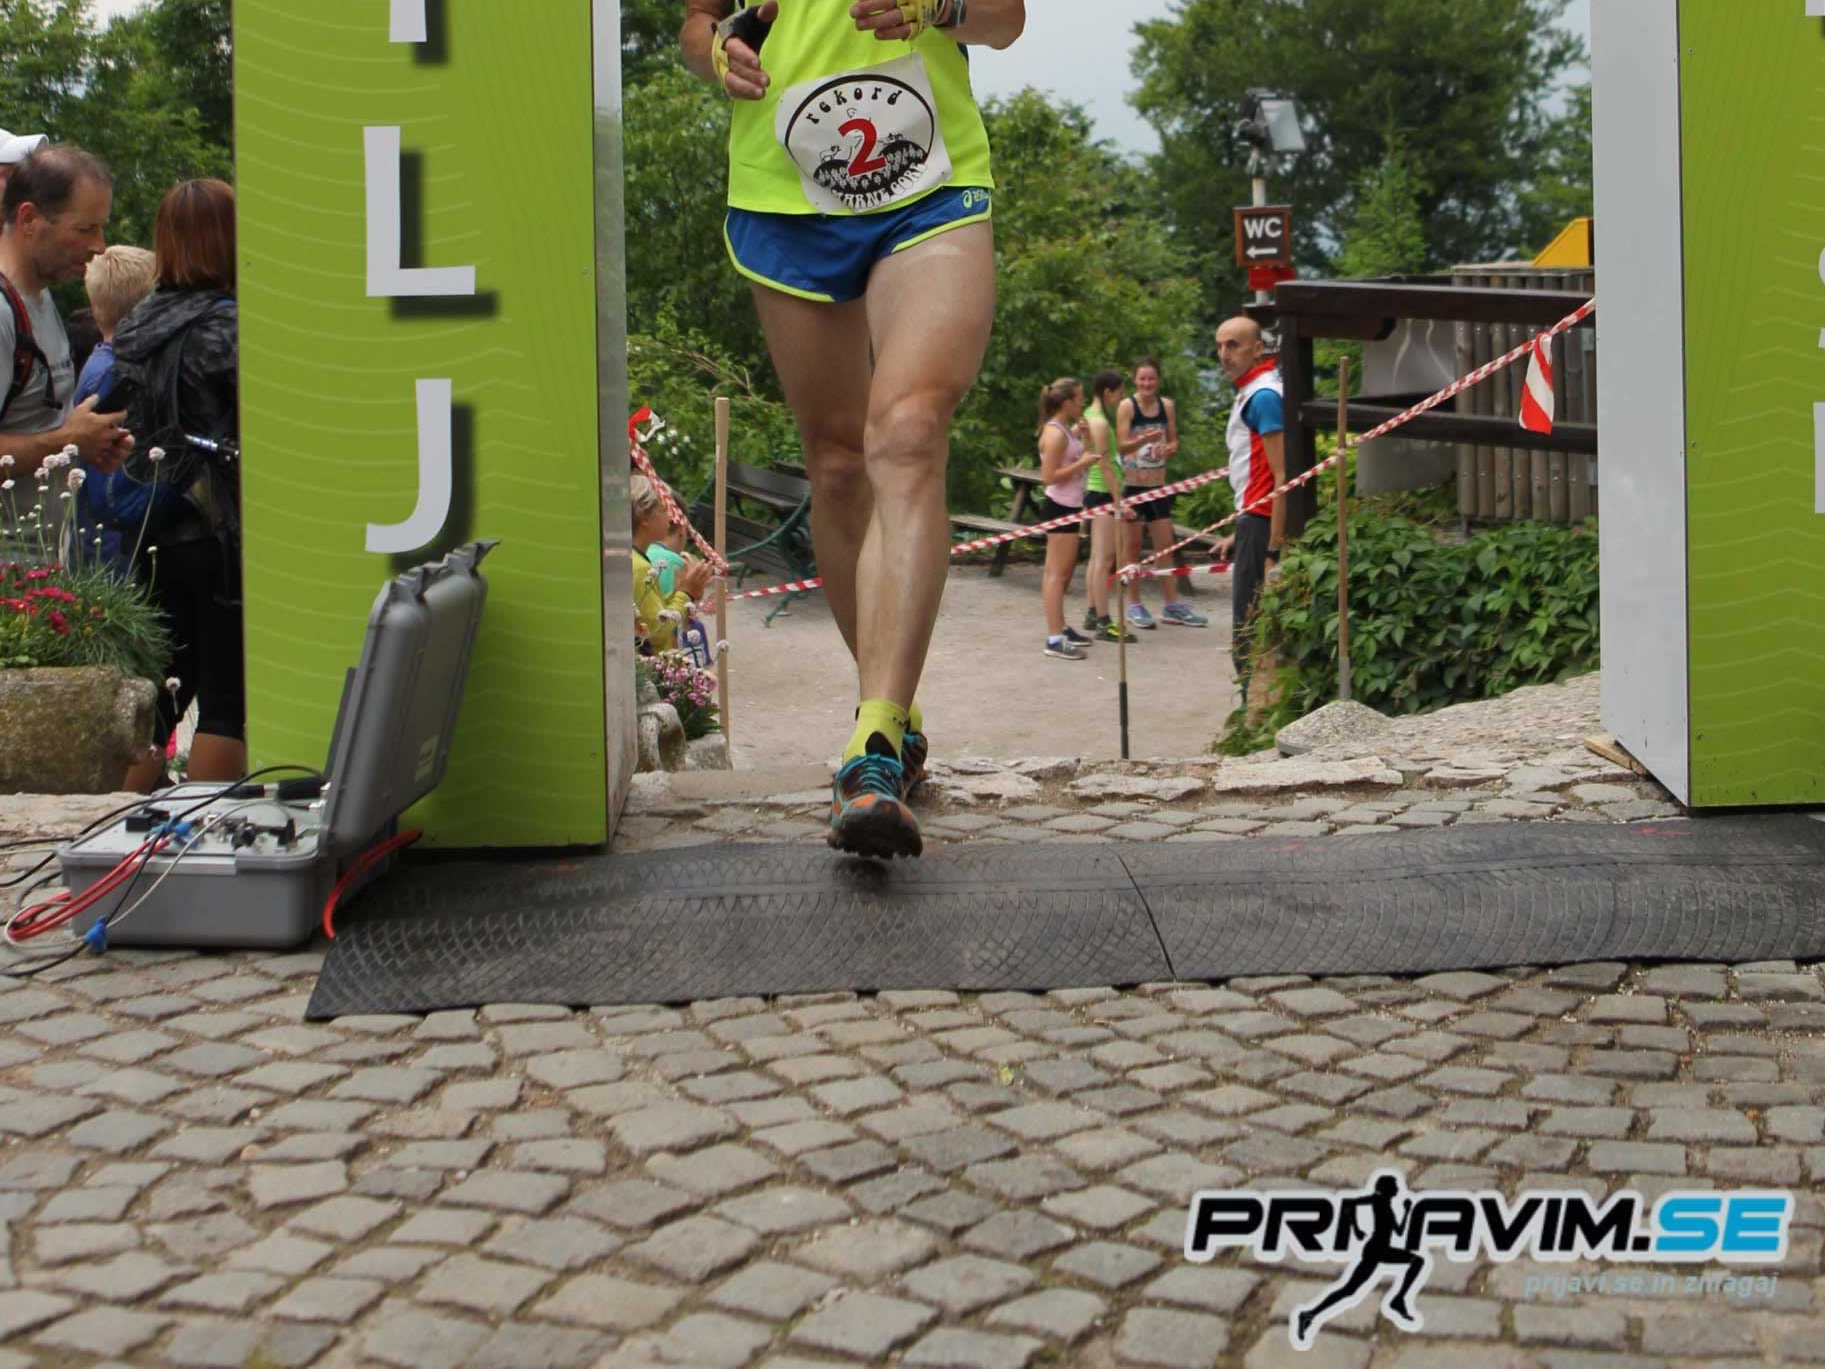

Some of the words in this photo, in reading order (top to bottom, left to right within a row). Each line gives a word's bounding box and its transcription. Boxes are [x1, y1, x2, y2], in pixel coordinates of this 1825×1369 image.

[805, 87, 903, 125] rekord
[837, 118, 887, 177] 2
[1243, 217, 1282, 239] WC
